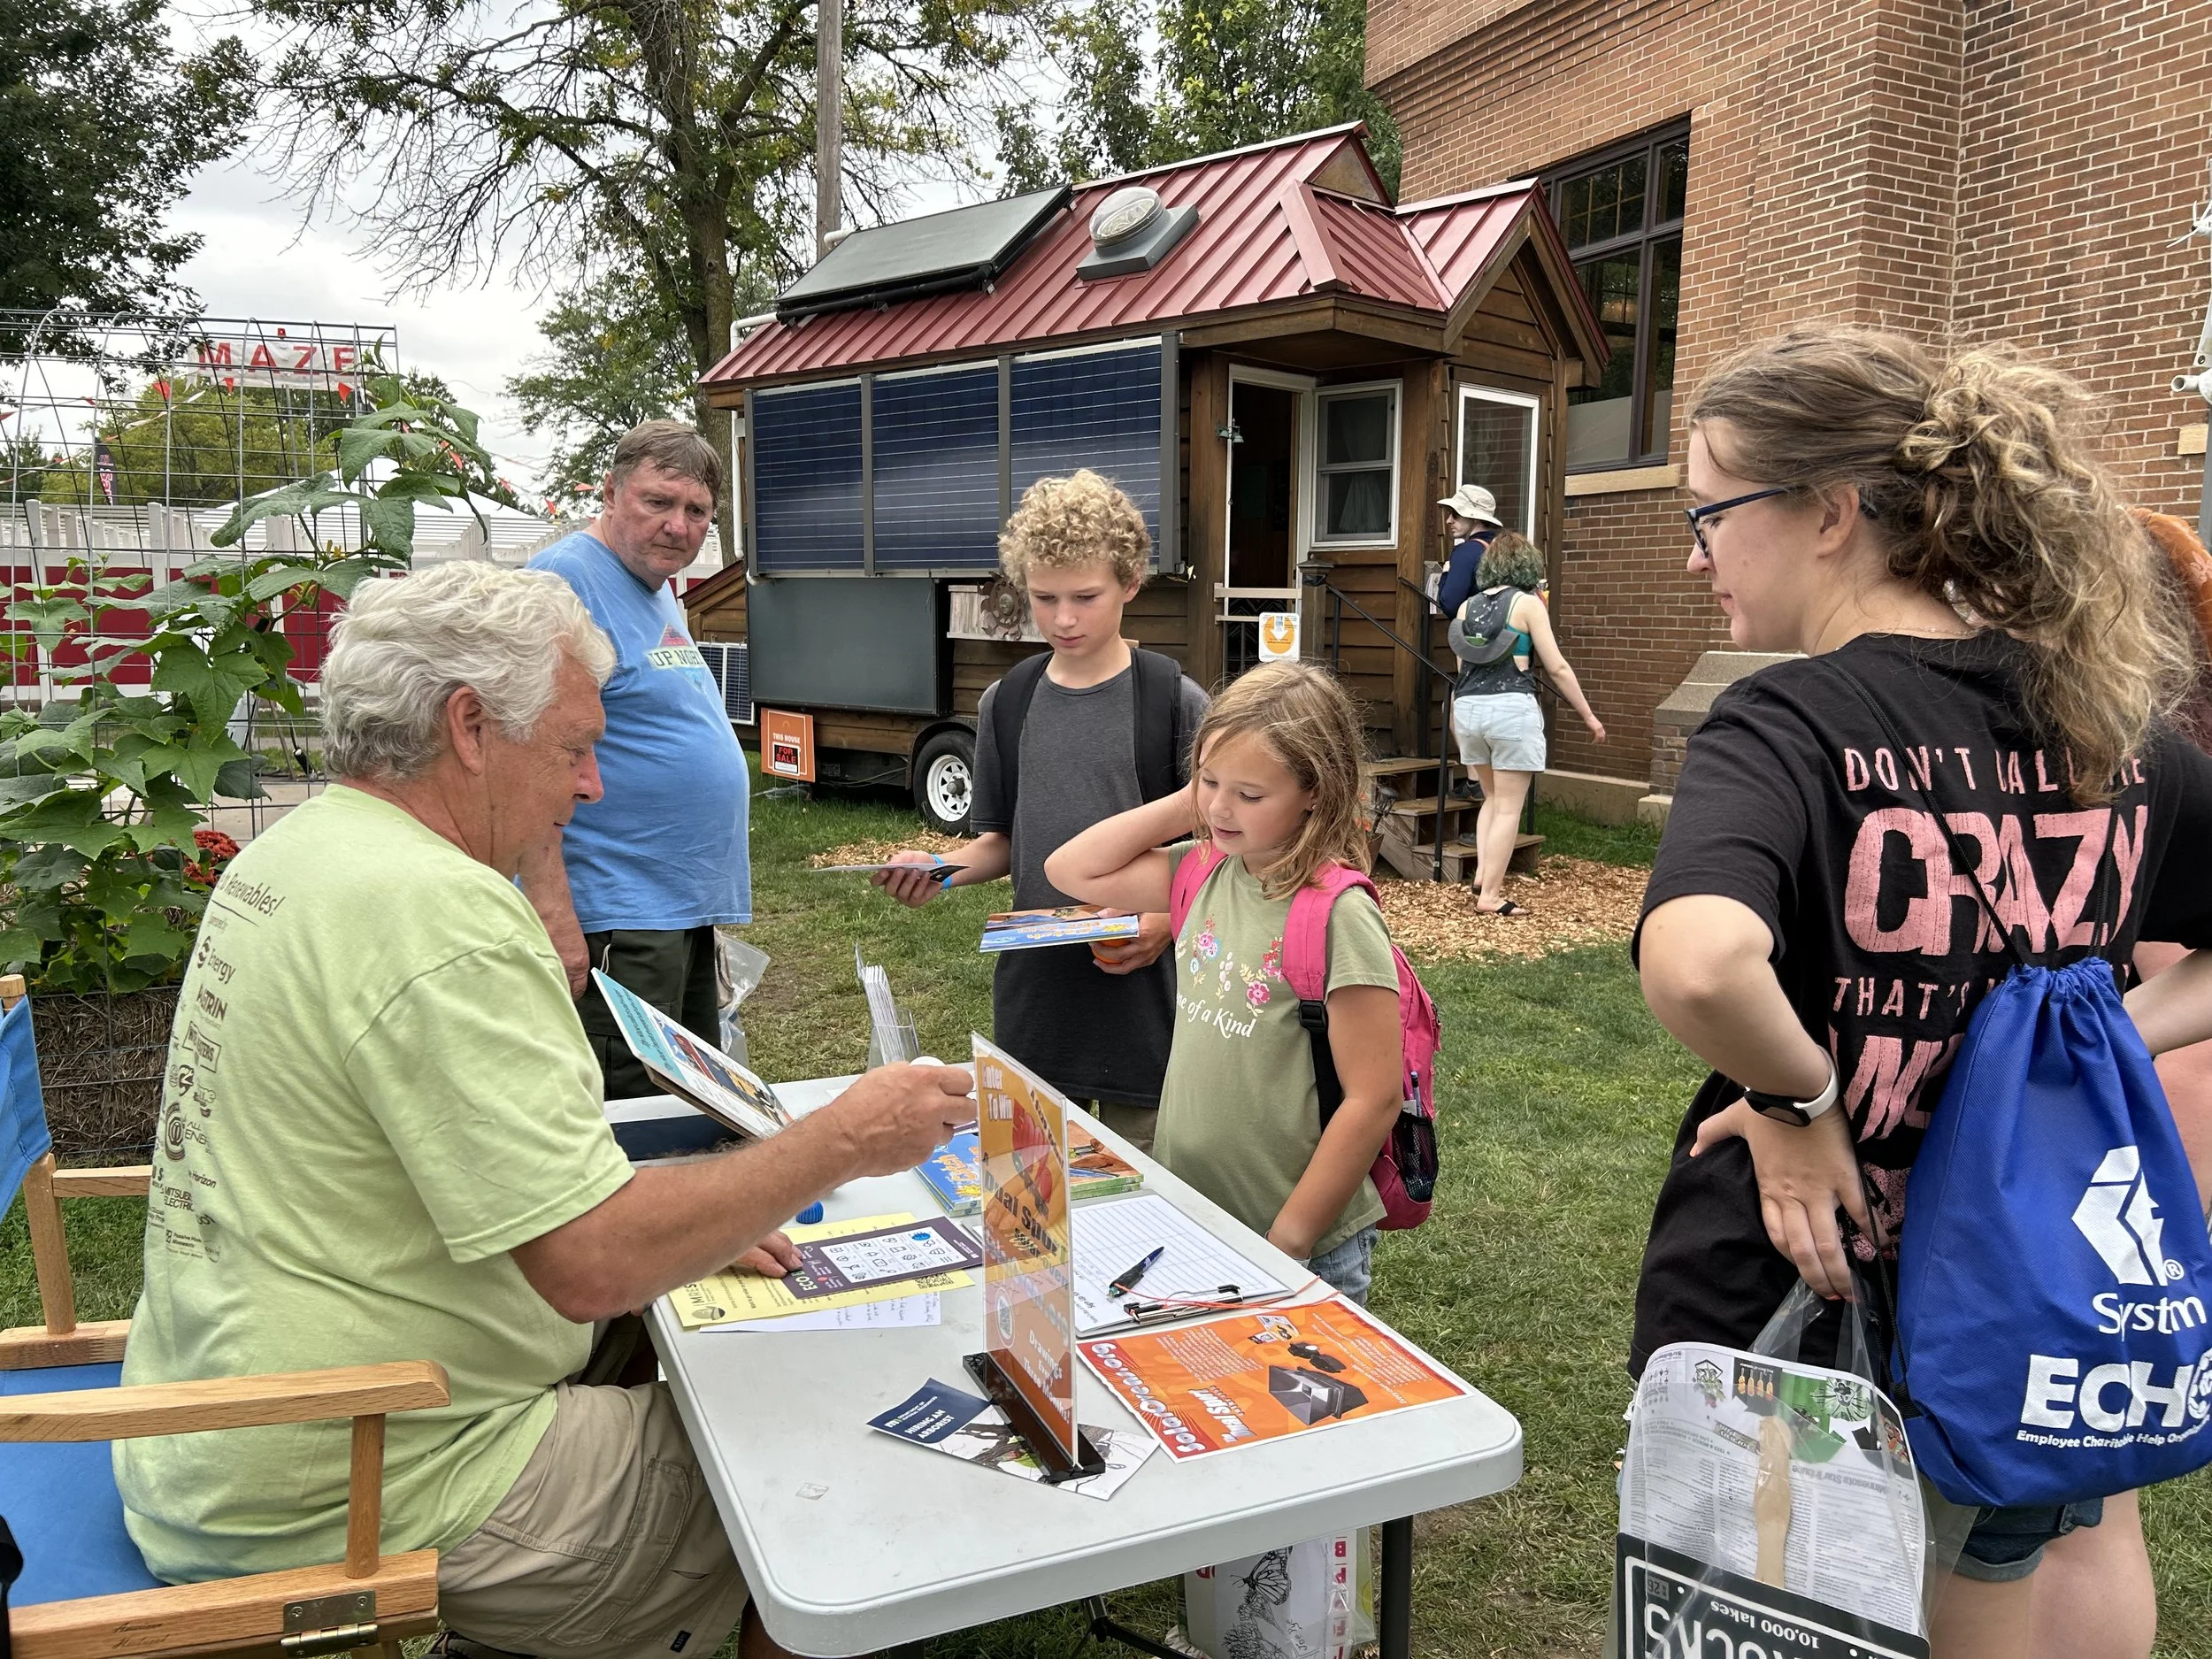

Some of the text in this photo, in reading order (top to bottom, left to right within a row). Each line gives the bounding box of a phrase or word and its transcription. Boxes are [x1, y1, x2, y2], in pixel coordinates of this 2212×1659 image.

[198, 342, 356, 376] MAZE
[649, 649, 704, 666] UP NOR
[772, 732, 801, 744] THIS HOUSE
[779, 746, 793, 755] FOR
[776, 754, 796, 764] SALE
[1844, 746, 1976, 792] DON'T
[1844, 804, 2148, 956] CRAZY
[227, 872, 287, 918] Renewables!
[1176, 992, 1256, 1039] ne of a Kind
[982, 1062, 1003, 1090] Enter
[988, 1093, 1012, 1120] To Win
[184, 1129, 209, 1145] ENER
[984, 1168, 1018, 1218] Dual
[795, 1276, 818, 1291] ECO
[2093, 1293, 2207, 1342] Systm
[1029, 1328, 1063, 1379] Drawings
[1024, 1356, 1070, 1425] Three Months!
[1091, 1342, 1207, 1453] SolarOvens.org
[1188, 1387, 1232, 1417] Sport
[904, 1409, 946, 1434] HIRING AN
[918, 1415, 955, 1439] ARBORIST
[2016, 1430, 2080, 1448] Employee
[2137, 1432, 2165, 1447] Help
[1710, 1601, 1755, 1628] lakes
[1295, 1634, 1308, 1651] Joe
